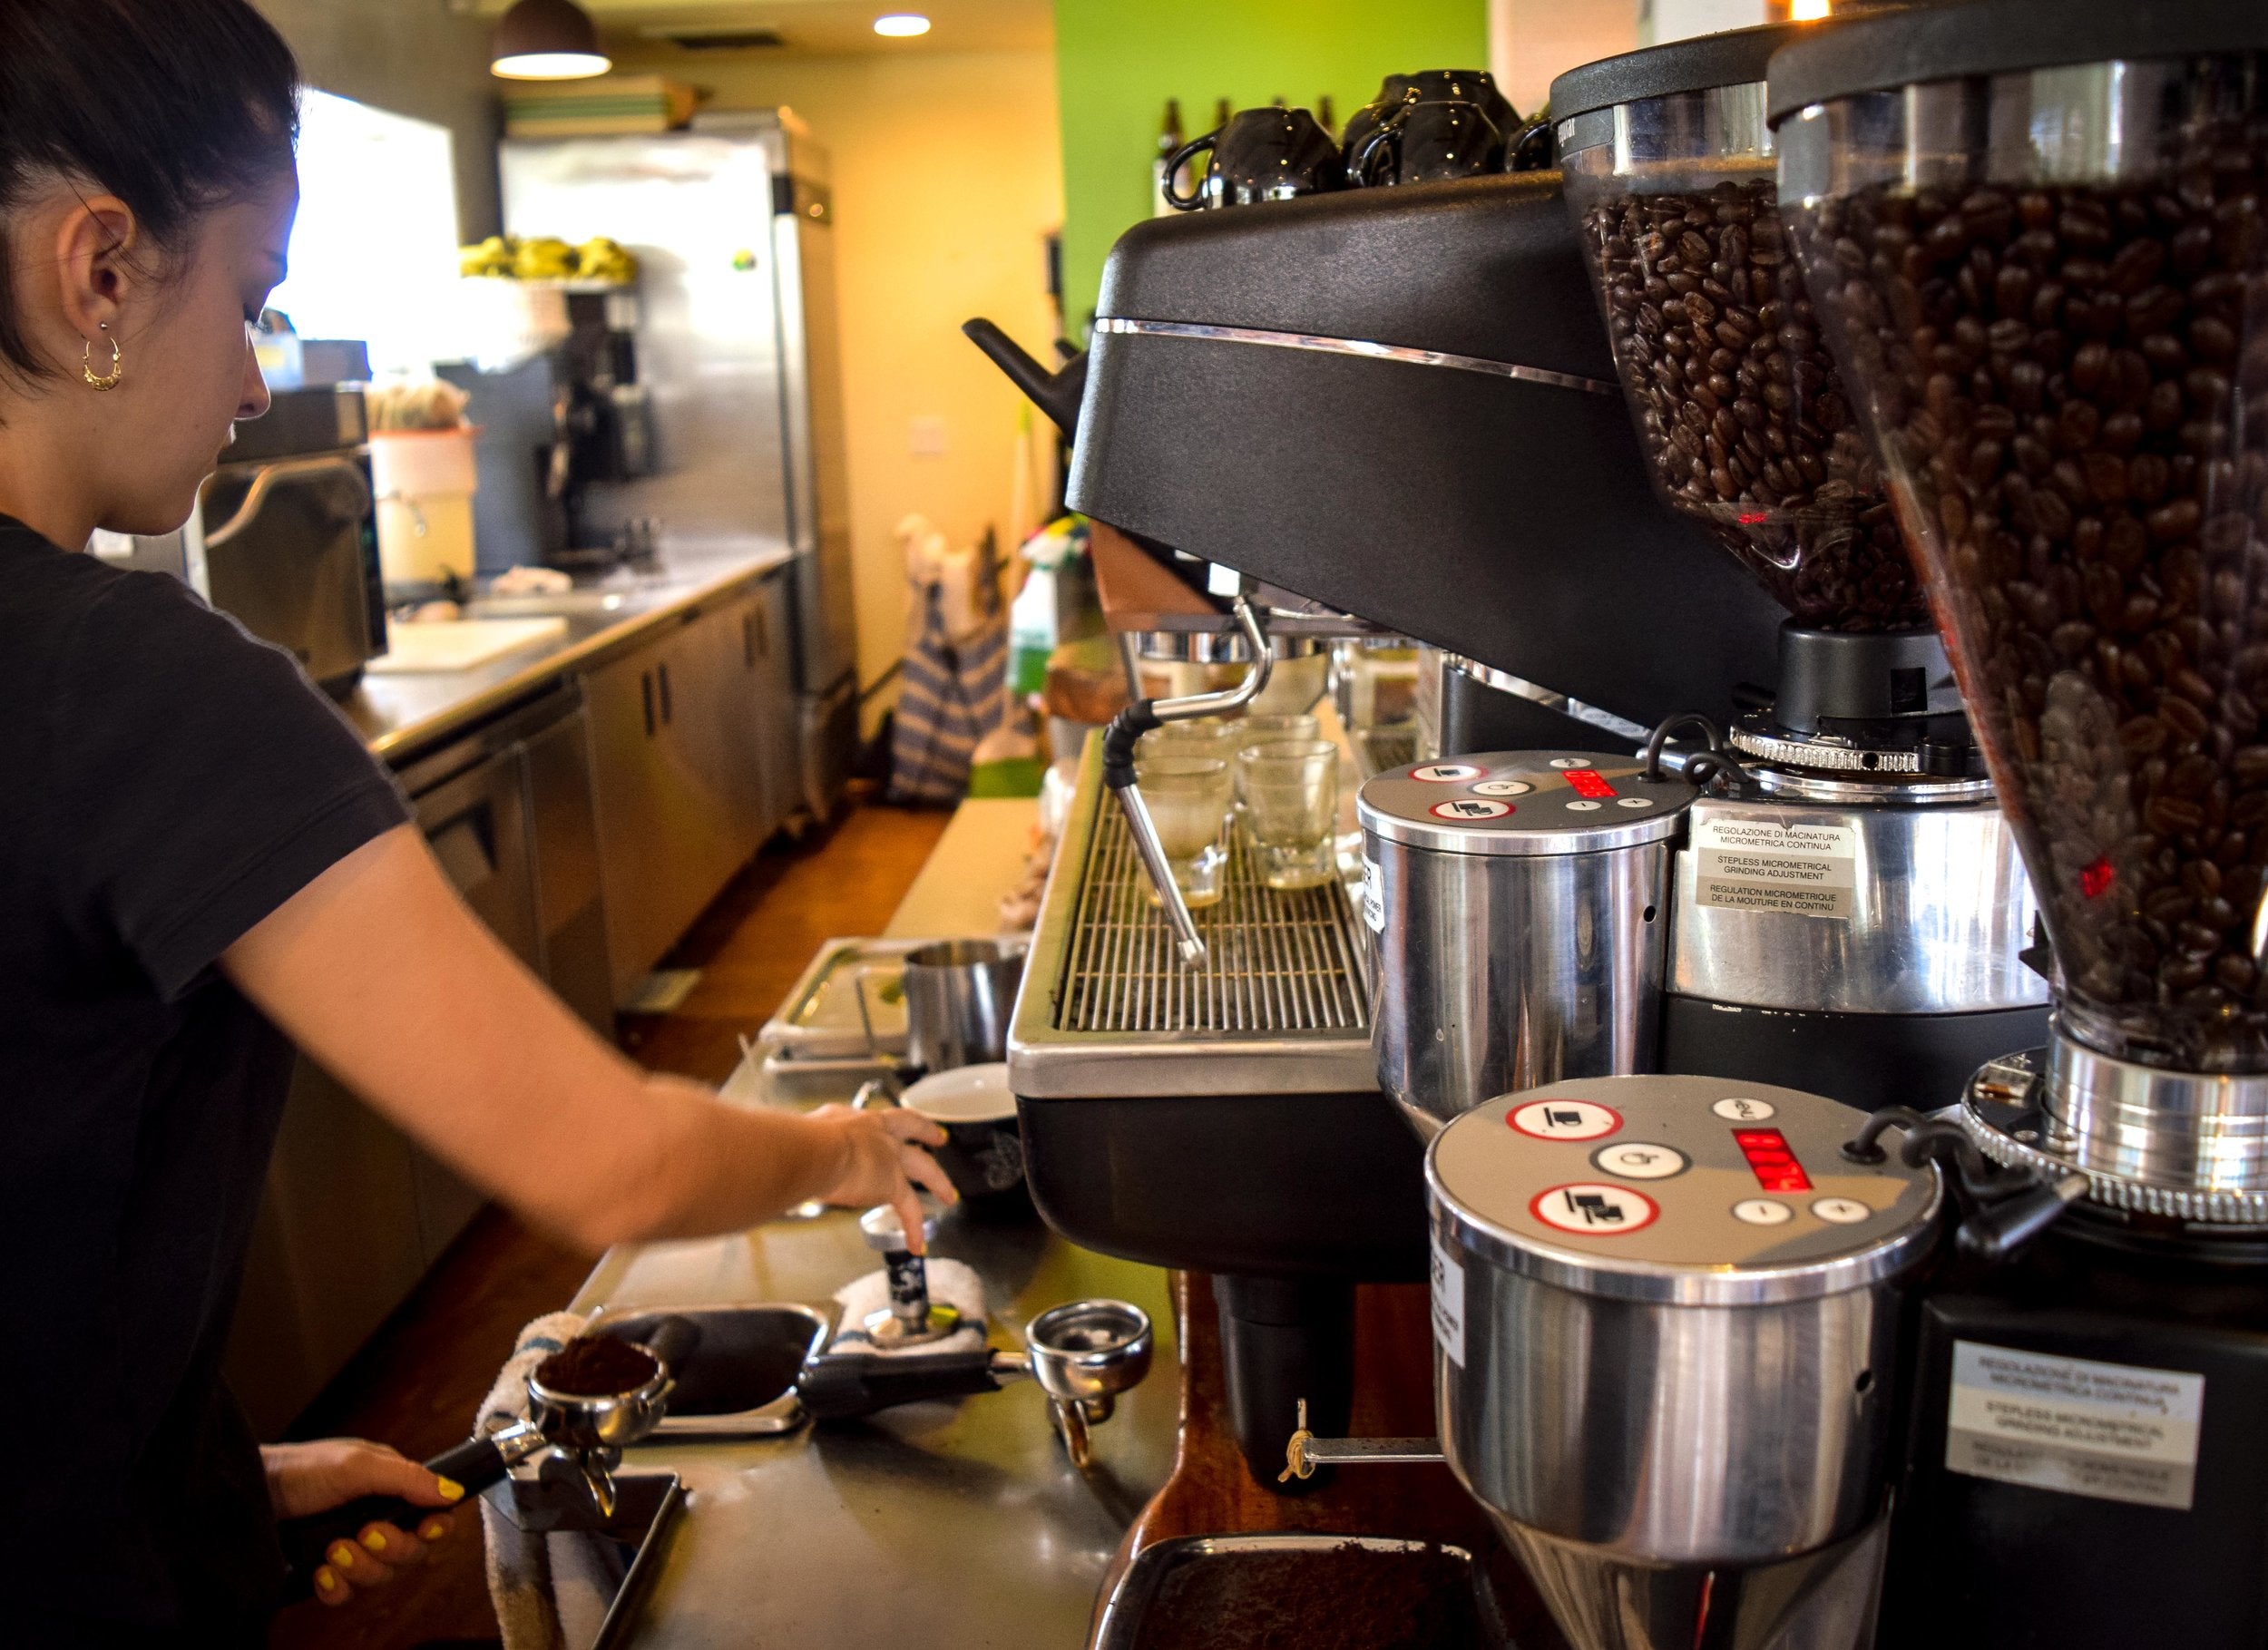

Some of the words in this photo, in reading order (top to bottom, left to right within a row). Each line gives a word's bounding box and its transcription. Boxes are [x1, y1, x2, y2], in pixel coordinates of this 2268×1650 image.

[1713, 825, 1773, 838] REGOLAZIONE
[1774, 830, 1784, 838] DI
[1784, 831, 1841, 842] MACINATURA
[1720, 835, 1785, 847] MICROMETRICA
[1786, 840, 1832, 851] CONTINUA
[1717, 855, 1760, 866] STEPLESS
[1761, 859, 1832, 871] MICROMETRICAL
[1724, 865, 1765, 876] GRINDING
[1766, 869, 1824, 880] ADJUSTMENT
[1710, 884, 1763, 896] REGULATION
[1764, 890, 1837, 903] MICROMETRIQUE
[1711, 893, 1724, 903] DE
[1725, 895, 1735, 903] LA
[1736, 897, 1779, 907] MOUTURE
[1780, 900, 1793, 908] EN
[1794, 901, 1834, 912] CONTINU
